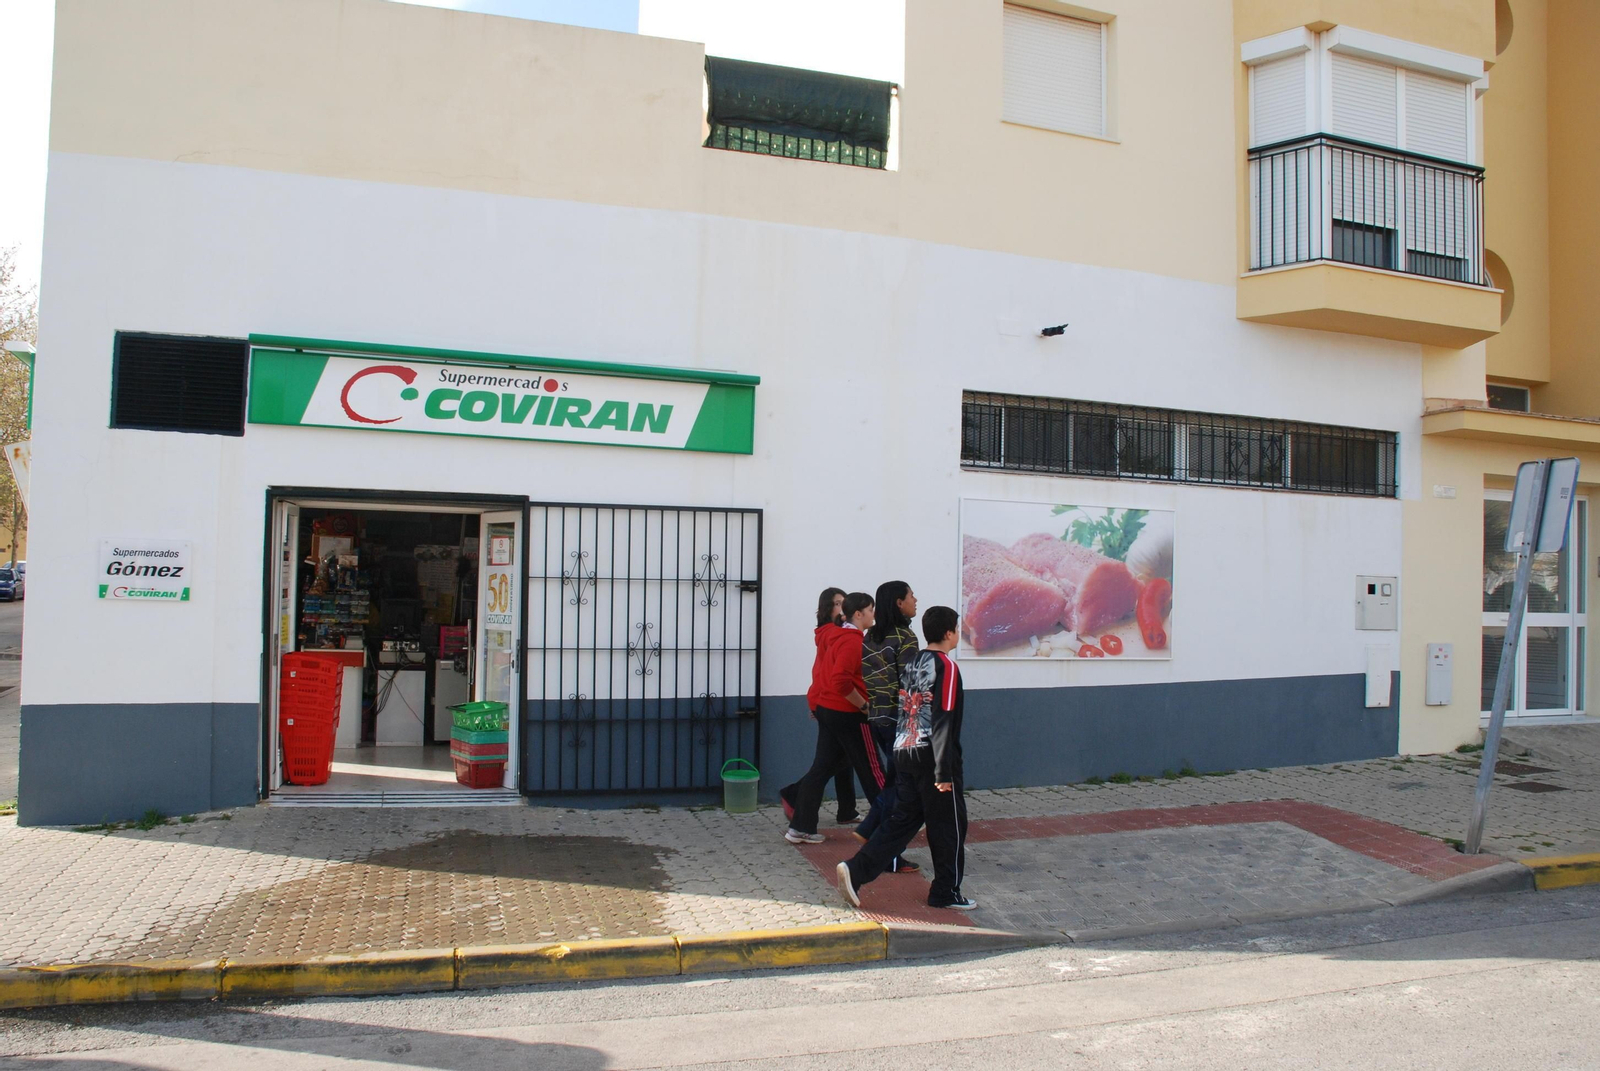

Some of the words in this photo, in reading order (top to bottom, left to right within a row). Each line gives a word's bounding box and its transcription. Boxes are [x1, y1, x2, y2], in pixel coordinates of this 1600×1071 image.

[424, 388, 674, 434] COVIRAN
[112, 547, 180, 559] Supermercados
[106, 561, 184, 578] Gómez
[127, 590, 178, 598] COVIRAN
[488, 573, 508, 613] 50
